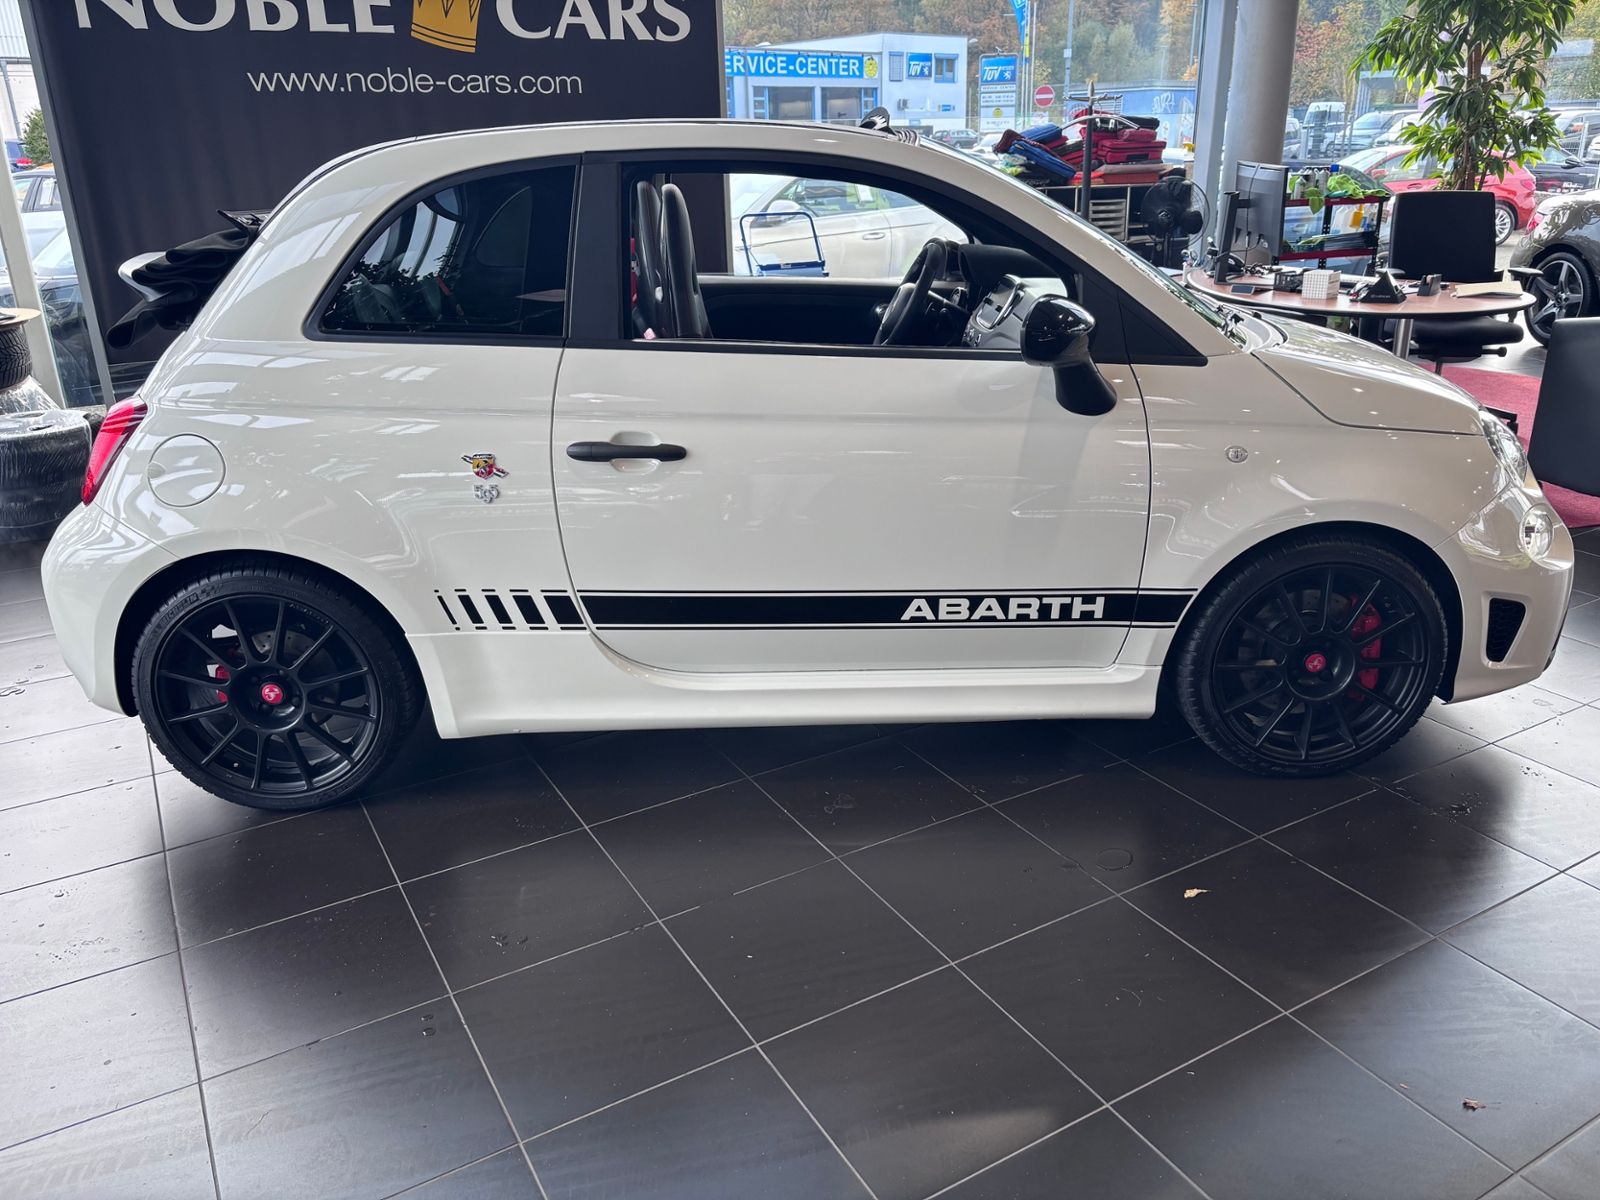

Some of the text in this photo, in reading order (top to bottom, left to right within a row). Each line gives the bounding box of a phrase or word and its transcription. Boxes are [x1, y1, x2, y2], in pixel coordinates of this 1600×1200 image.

[246, 67, 583, 94] www.noble-cars.com
[473, 484, 500, 504] 595
[900, 597, 1106, 620] ABARTH
